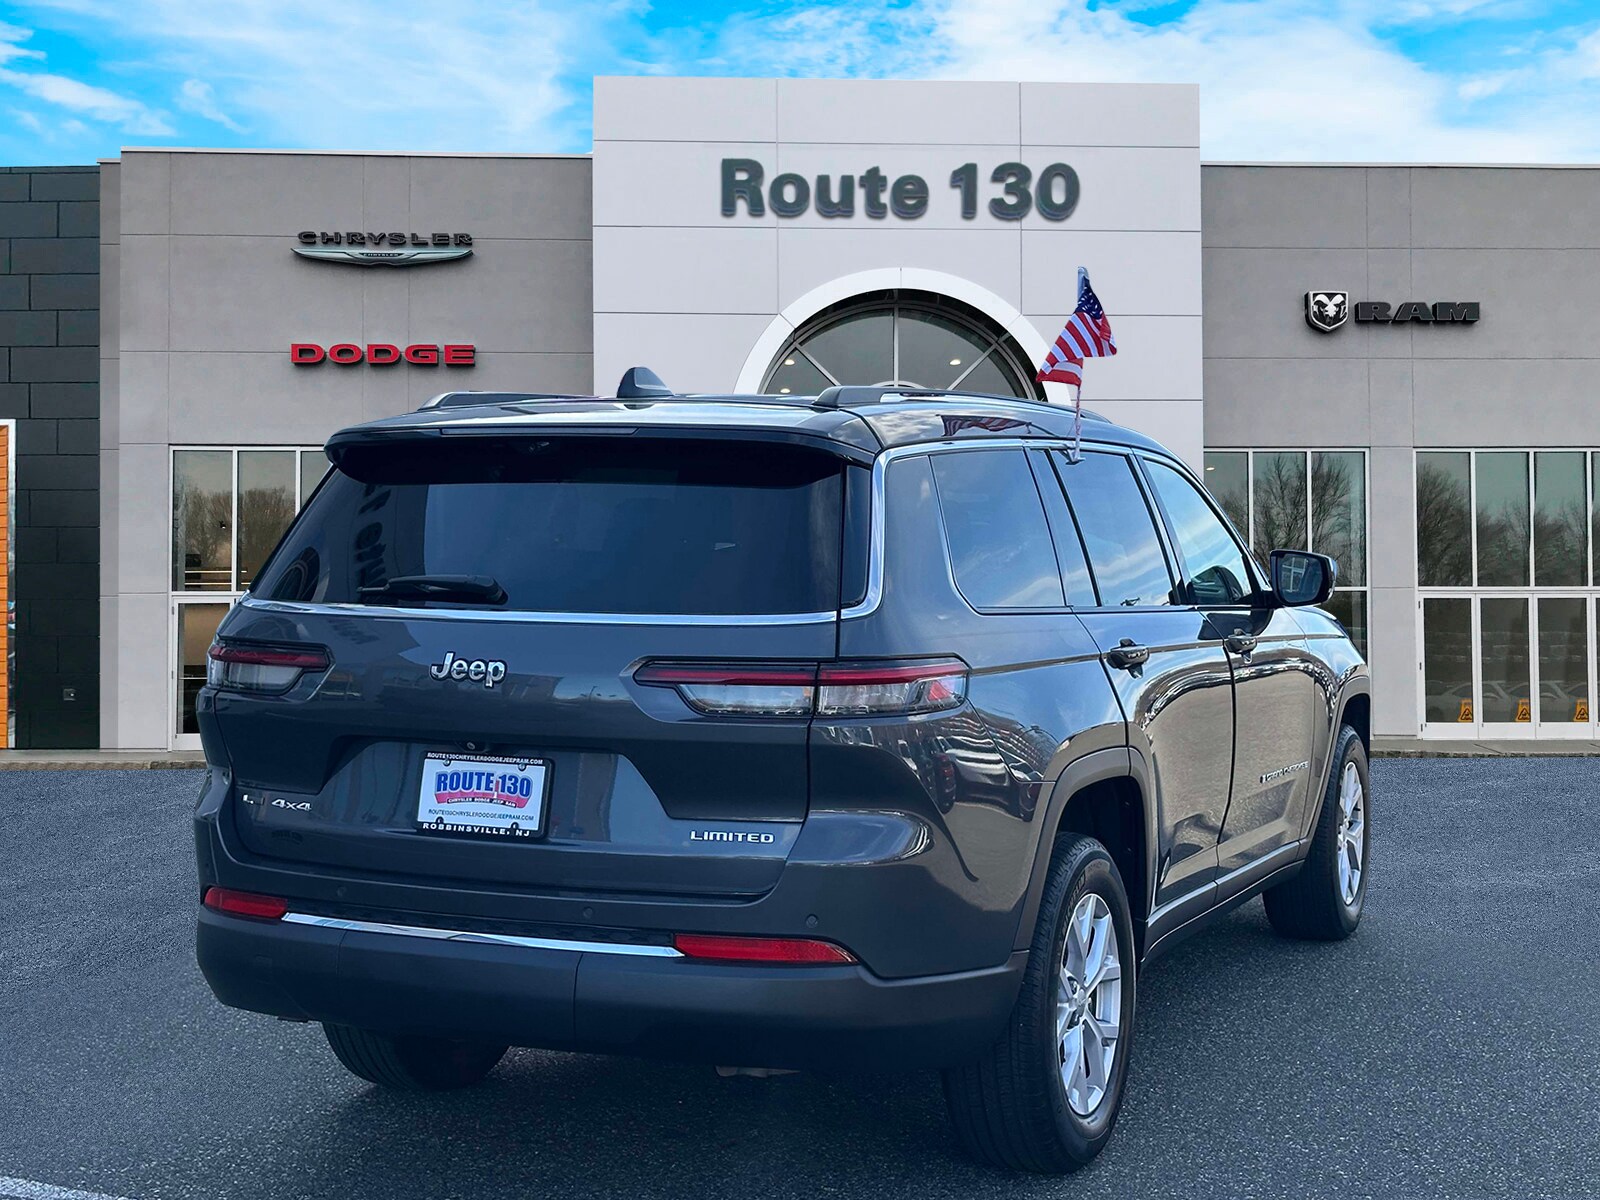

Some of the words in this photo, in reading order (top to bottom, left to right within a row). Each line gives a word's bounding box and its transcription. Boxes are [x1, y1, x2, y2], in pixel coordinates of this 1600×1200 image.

[721, 158, 929, 218] Route
[950, 162, 1080, 221] 130
[298, 231, 473, 245] CHRYSLER
[1355, 302, 1480, 323] RAM
[291, 343, 476, 365] DODGE
[430, 651, 506, 688] Jeep
[436, 771, 495, 792] ROUTE
[498, 774, 532, 798] 130
[271, 798, 312, 811] 4x4
[422, 822, 510, 835] ROBBINSVILLE,
[515, 828, 530, 837] NJ
[690, 831, 775, 843] LIMITED
